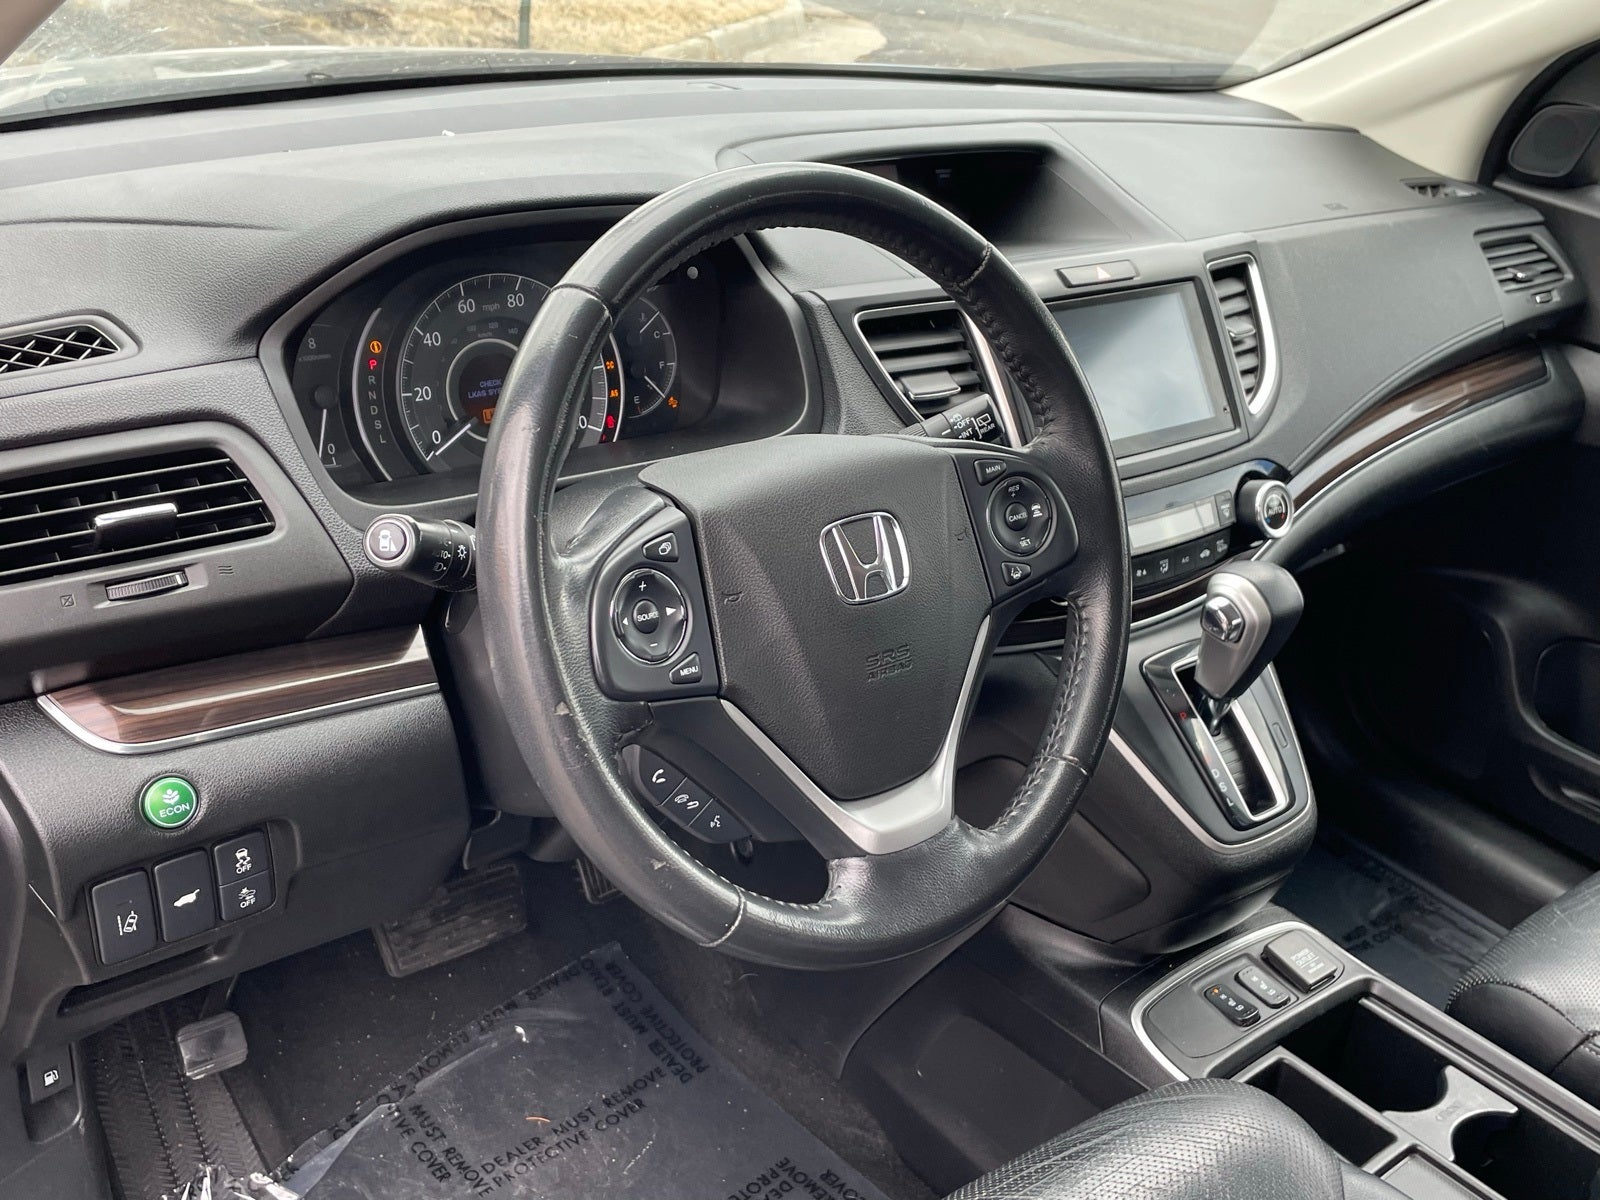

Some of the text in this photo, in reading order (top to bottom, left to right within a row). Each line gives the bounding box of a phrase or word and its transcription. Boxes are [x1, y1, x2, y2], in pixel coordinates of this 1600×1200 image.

[458, 299, 475, 313] 60
[507, 293, 525, 308] 80
[482, 302, 500, 312] mph
[308, 338, 316, 349] 8
[423, 332, 441, 347] 40
[370, 360, 377, 369] P
[659, 361, 665, 369] F
[480, 378, 502, 388] CHECK
[414, 386, 432, 402] 20
[468, 390, 487, 399] LKAS
[634, 396, 640, 404] E
[368, 376, 387, 444] R N D S L
[957, 417, 970, 429] OFF
[980, 423, 995, 434] REAR
[432, 430, 441, 444] 0
[961, 428, 973, 438] INT
[327, 443, 335, 454] 0
[985, 465, 1001, 474] MAIN
[1008, 484, 1020, 493] RES
[1268, 506, 1282, 516] AUTO
[1020, 538, 1031, 547] SET
[637, 610, 659, 622] SOURCE
[865, 644, 911, 667] SRS
[680, 665, 698, 676] MENU
[1211, 769, 1219, 778] D
[1219, 782, 1227, 792] S
[159, 802, 190, 818] ECON
[236, 863, 252, 874] OFF
[240, 897, 256, 908] OFF
[605, 962, 710, 1074] PROTECTIVE COVER
[612, 1002, 649, 1035] MUST
[648, 1039, 694, 1084] DEALER
[482, 1066, 667, 1174] DEALER MUST REMOVE
[492, 1098, 648, 1187] PROTECTIVE COVER
[409, 1104, 495, 1198] MUST REMOVE
[411, 1141, 452, 1183] COVER
[820, 1169, 866, 1200] OVER
